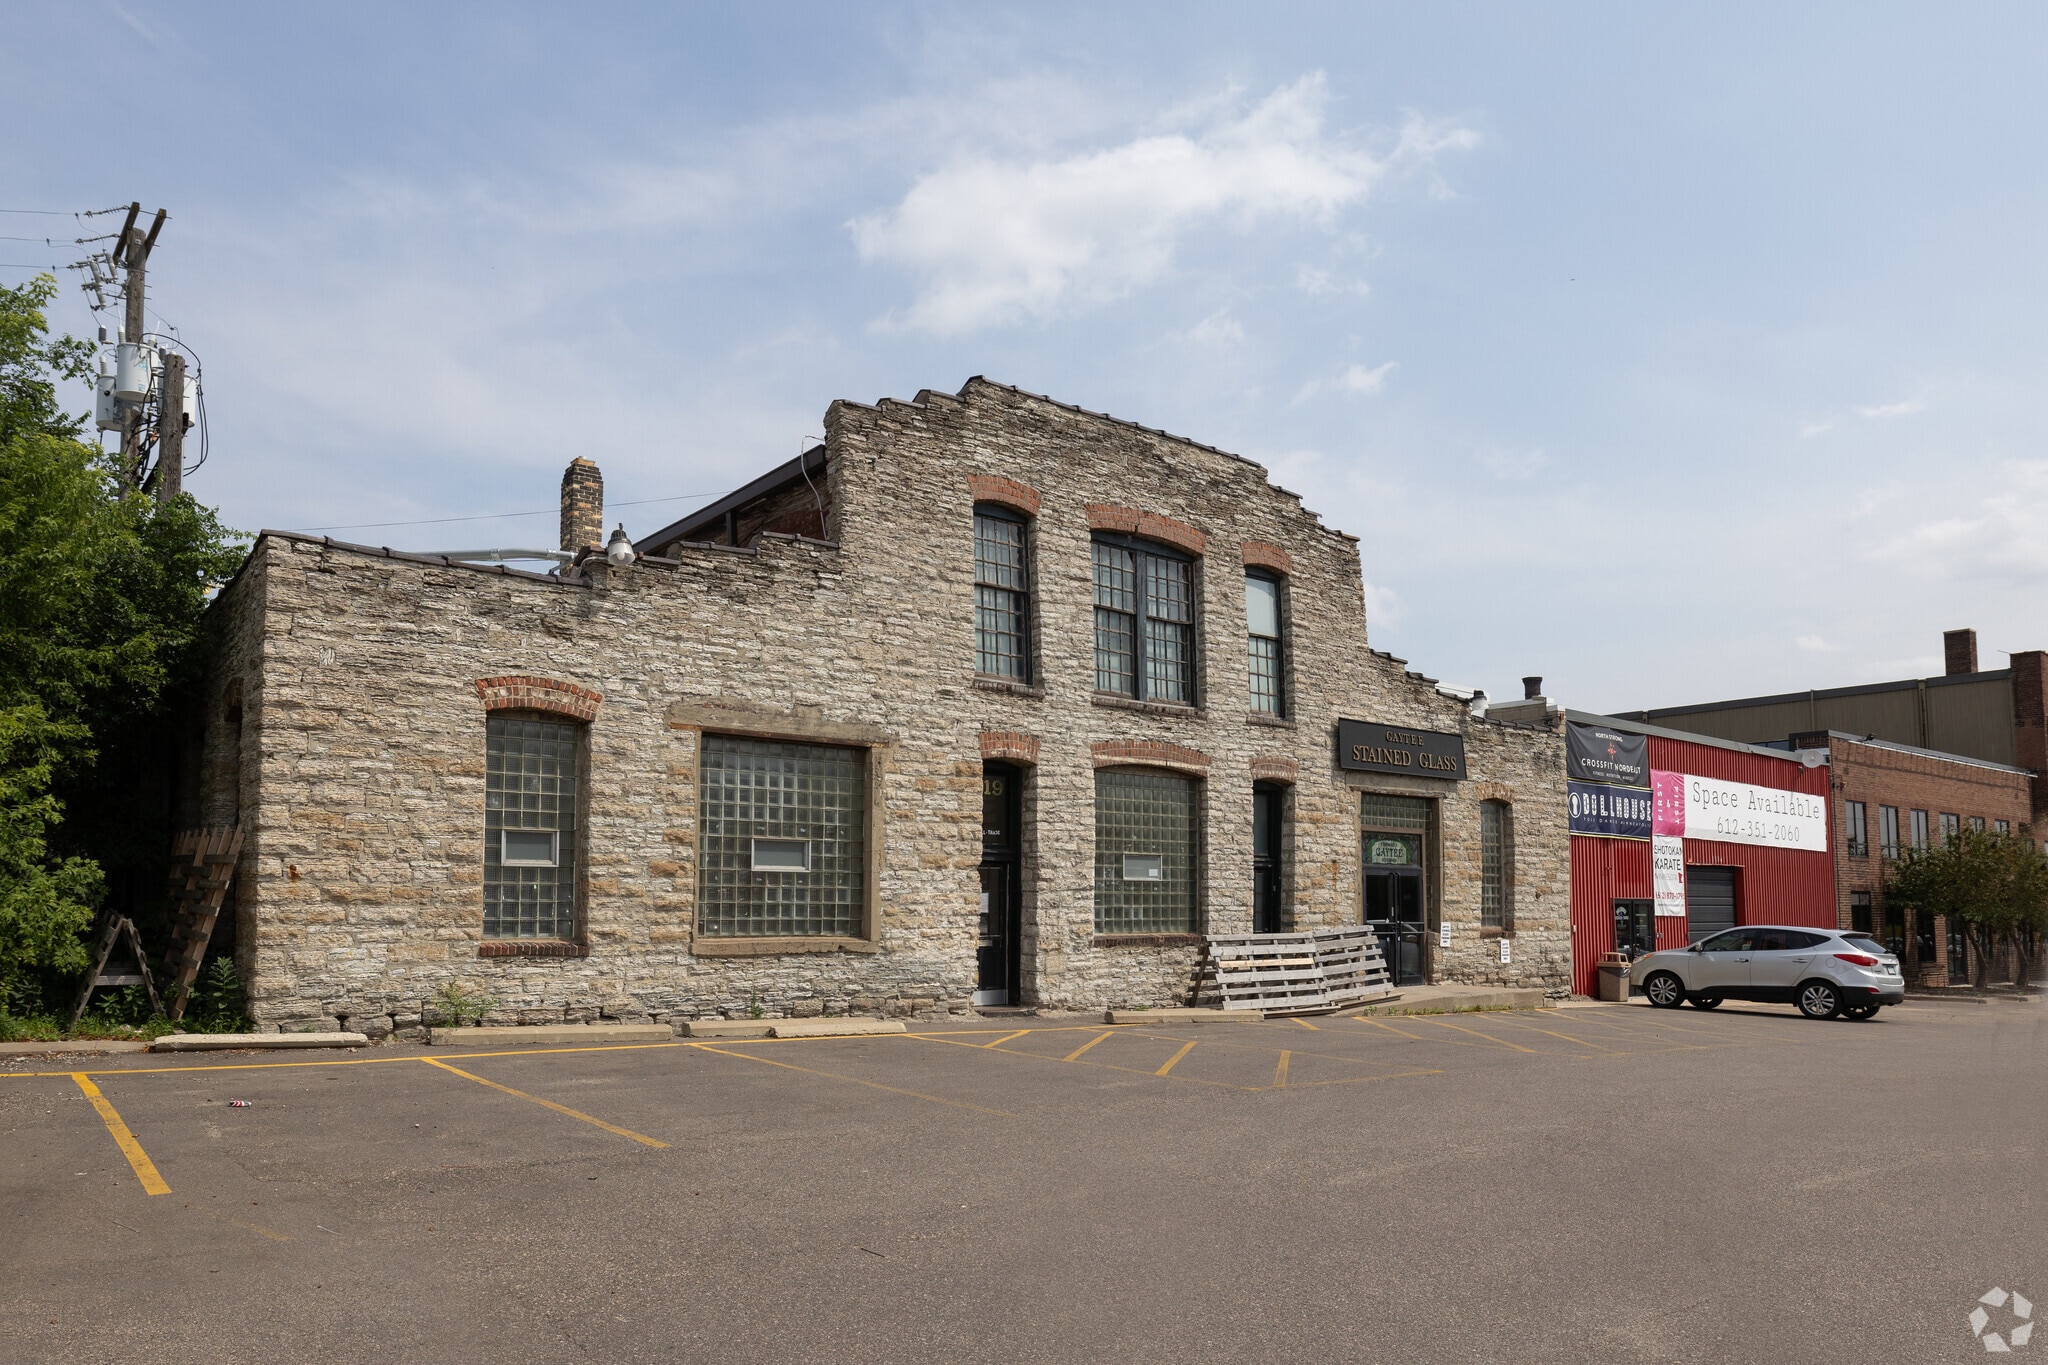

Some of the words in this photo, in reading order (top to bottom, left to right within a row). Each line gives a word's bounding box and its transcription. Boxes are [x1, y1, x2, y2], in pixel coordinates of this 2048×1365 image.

[1386, 730, 1424, 746] GAYTEE
[1353, 744, 1411, 766] STAINED
[1418, 752, 1457, 771] GLASS
[1581, 758, 1613, 770] CROSSFIT
[1582, 792, 1651, 821] DOLLHOUSE
[1693, 781, 1738, 810] Space
[1748, 790, 1820, 819] Available
[1717, 817, 1800, 841] 612-351-2060
[1375, 847, 1403, 857] GAYTEE
[1654, 857, 1681, 870] KARATE
